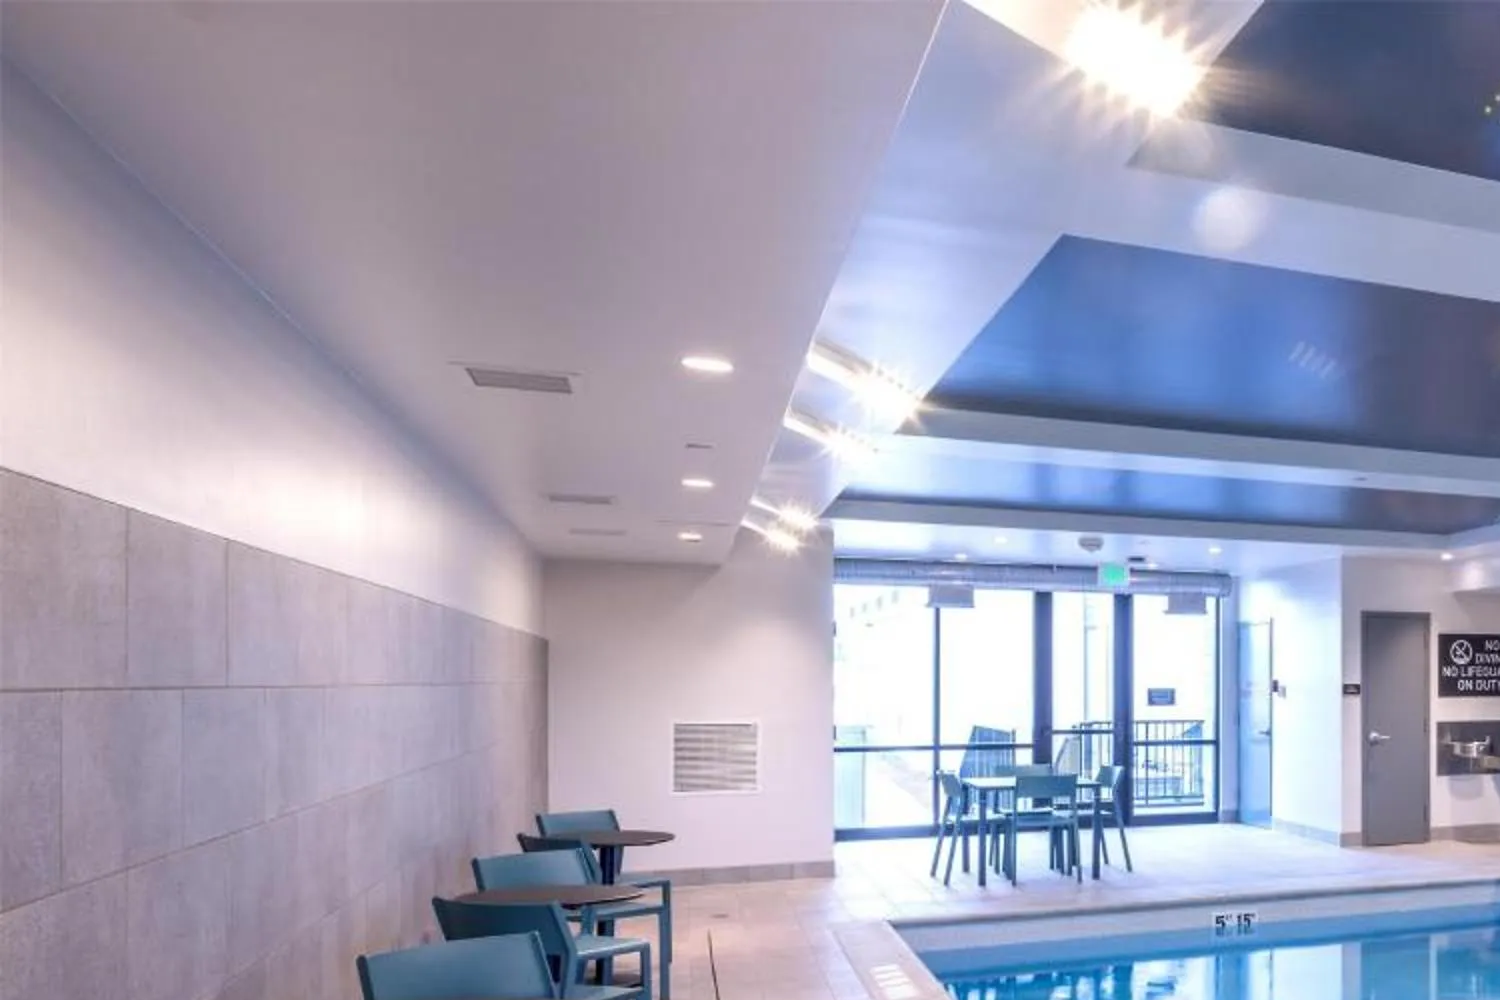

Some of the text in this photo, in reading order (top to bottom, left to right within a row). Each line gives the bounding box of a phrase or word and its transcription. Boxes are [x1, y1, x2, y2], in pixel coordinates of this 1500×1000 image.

[1485, 640, 1500, 651] NO
[1442, 666, 1458, 677] NO
[1457, 680, 1472, 691] ON
